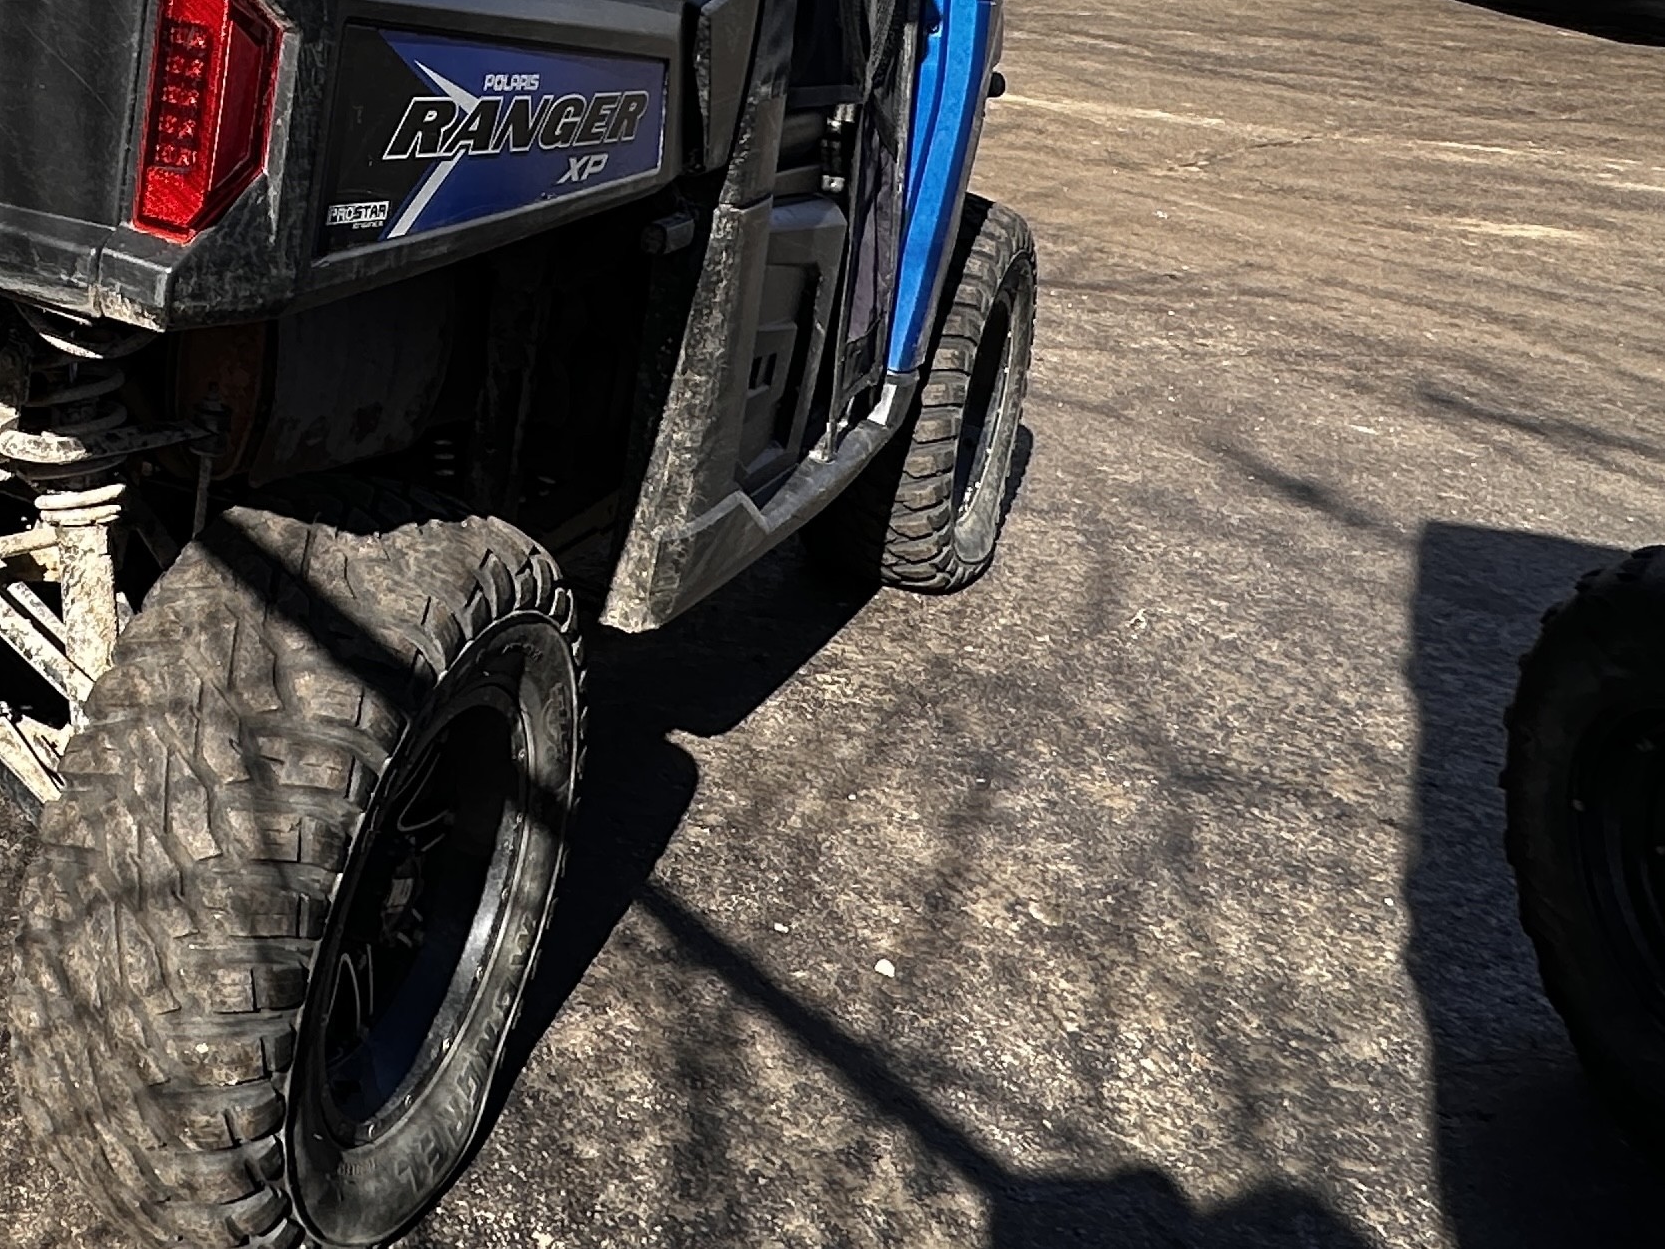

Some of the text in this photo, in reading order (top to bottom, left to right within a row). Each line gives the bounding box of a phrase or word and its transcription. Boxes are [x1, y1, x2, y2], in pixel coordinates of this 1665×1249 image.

[483, 74, 540, 91] POLARIS
[383, 91, 649, 160] RANGER
[556, 153, 609, 184] XP
[329, 204, 387, 223] PROSTAR
